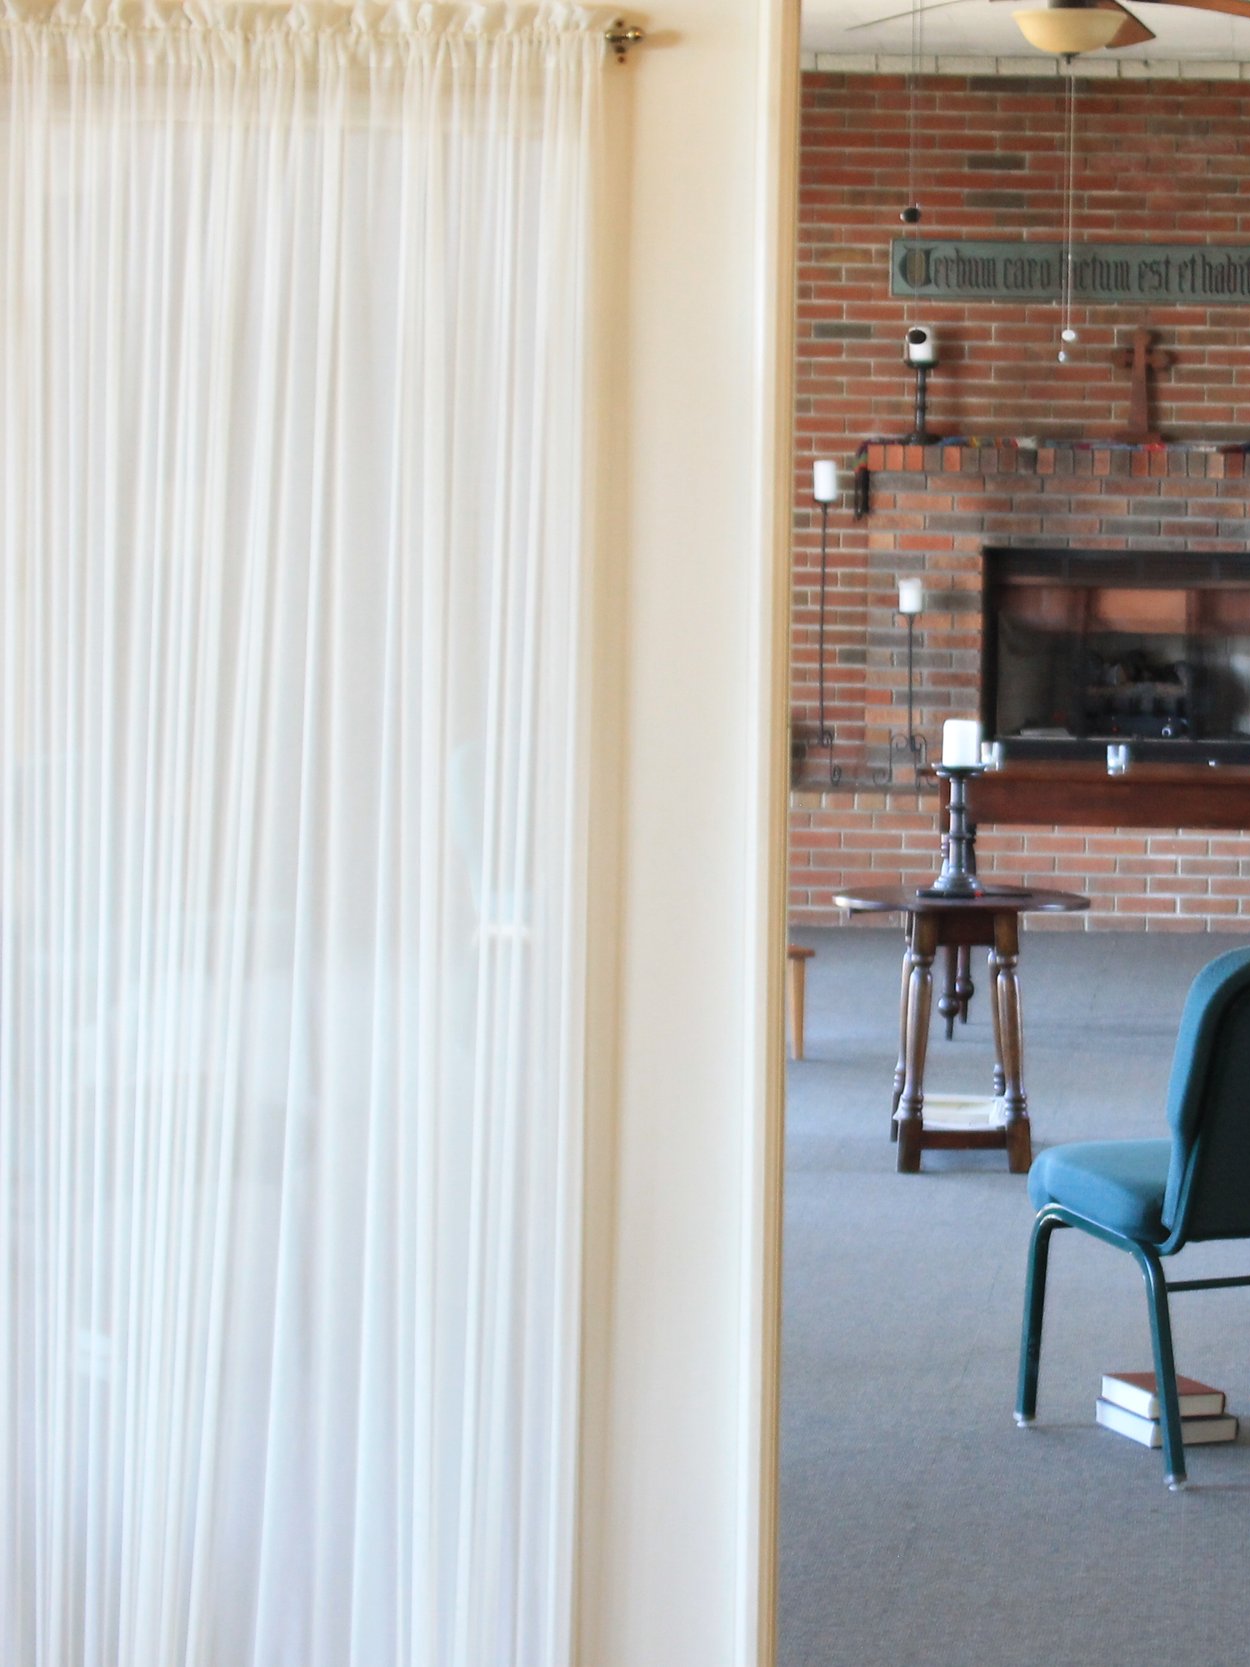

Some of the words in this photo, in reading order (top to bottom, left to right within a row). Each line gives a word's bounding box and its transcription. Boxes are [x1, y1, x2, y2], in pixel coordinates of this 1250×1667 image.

[1003, 256, 1051, 290] caro
[1137, 254, 1171, 294] est
[1178, 254, 1198, 294] et
